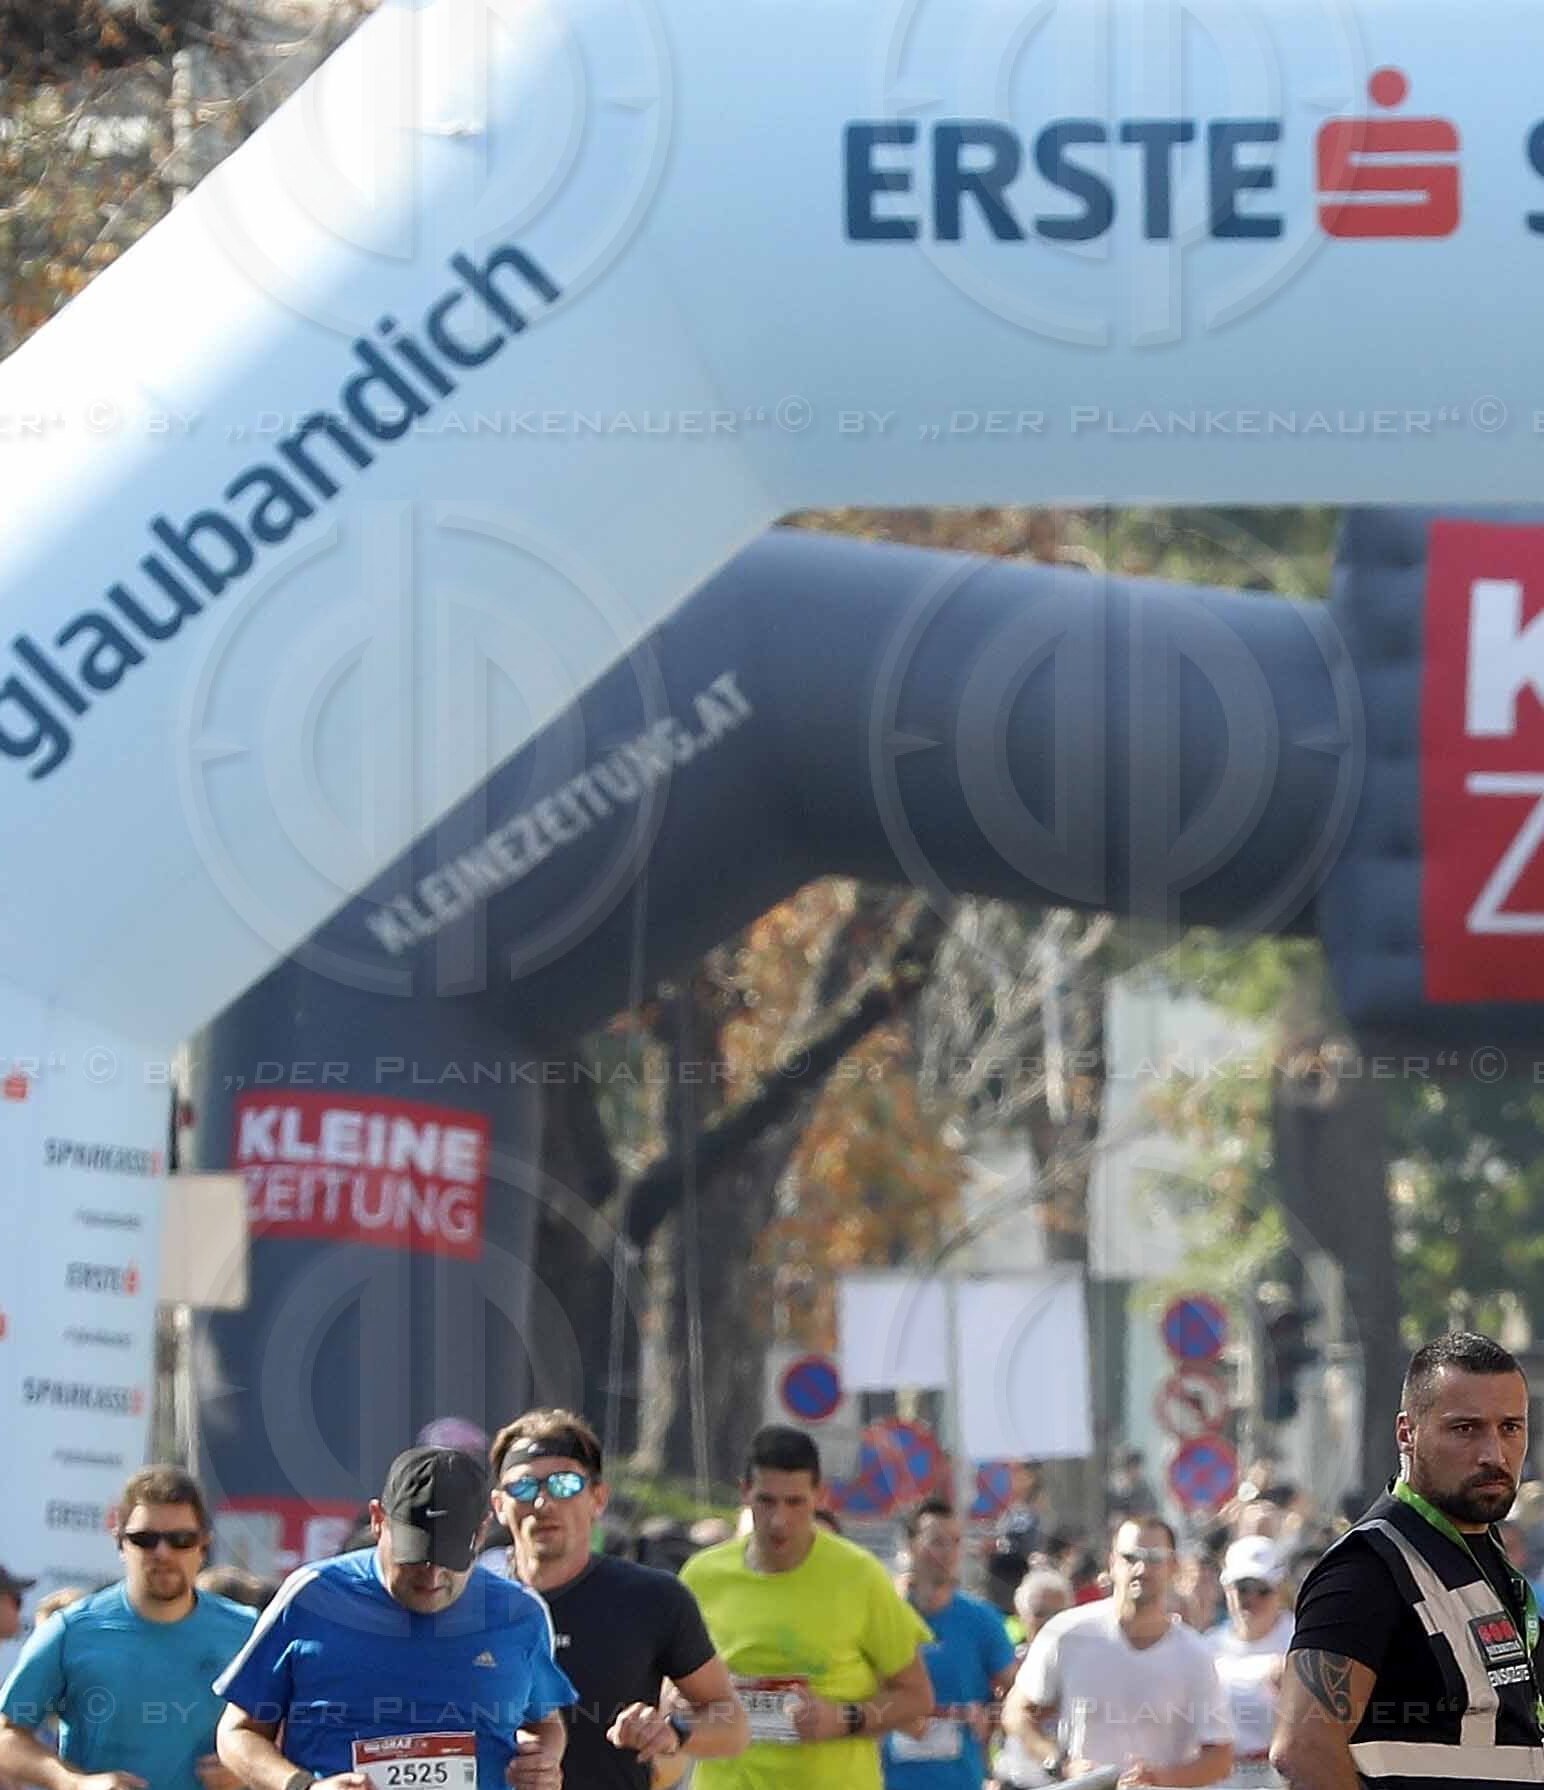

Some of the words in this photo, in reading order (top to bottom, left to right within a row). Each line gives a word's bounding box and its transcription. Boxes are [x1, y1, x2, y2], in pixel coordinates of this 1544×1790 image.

[842, 119, 1283, 243] ERSTE
[363, 671, 754, 955] KLEINEZEITUNG.AT
[239, 1104, 480, 1183] KLEINE
[387, 1762, 448, 1785] 2525
